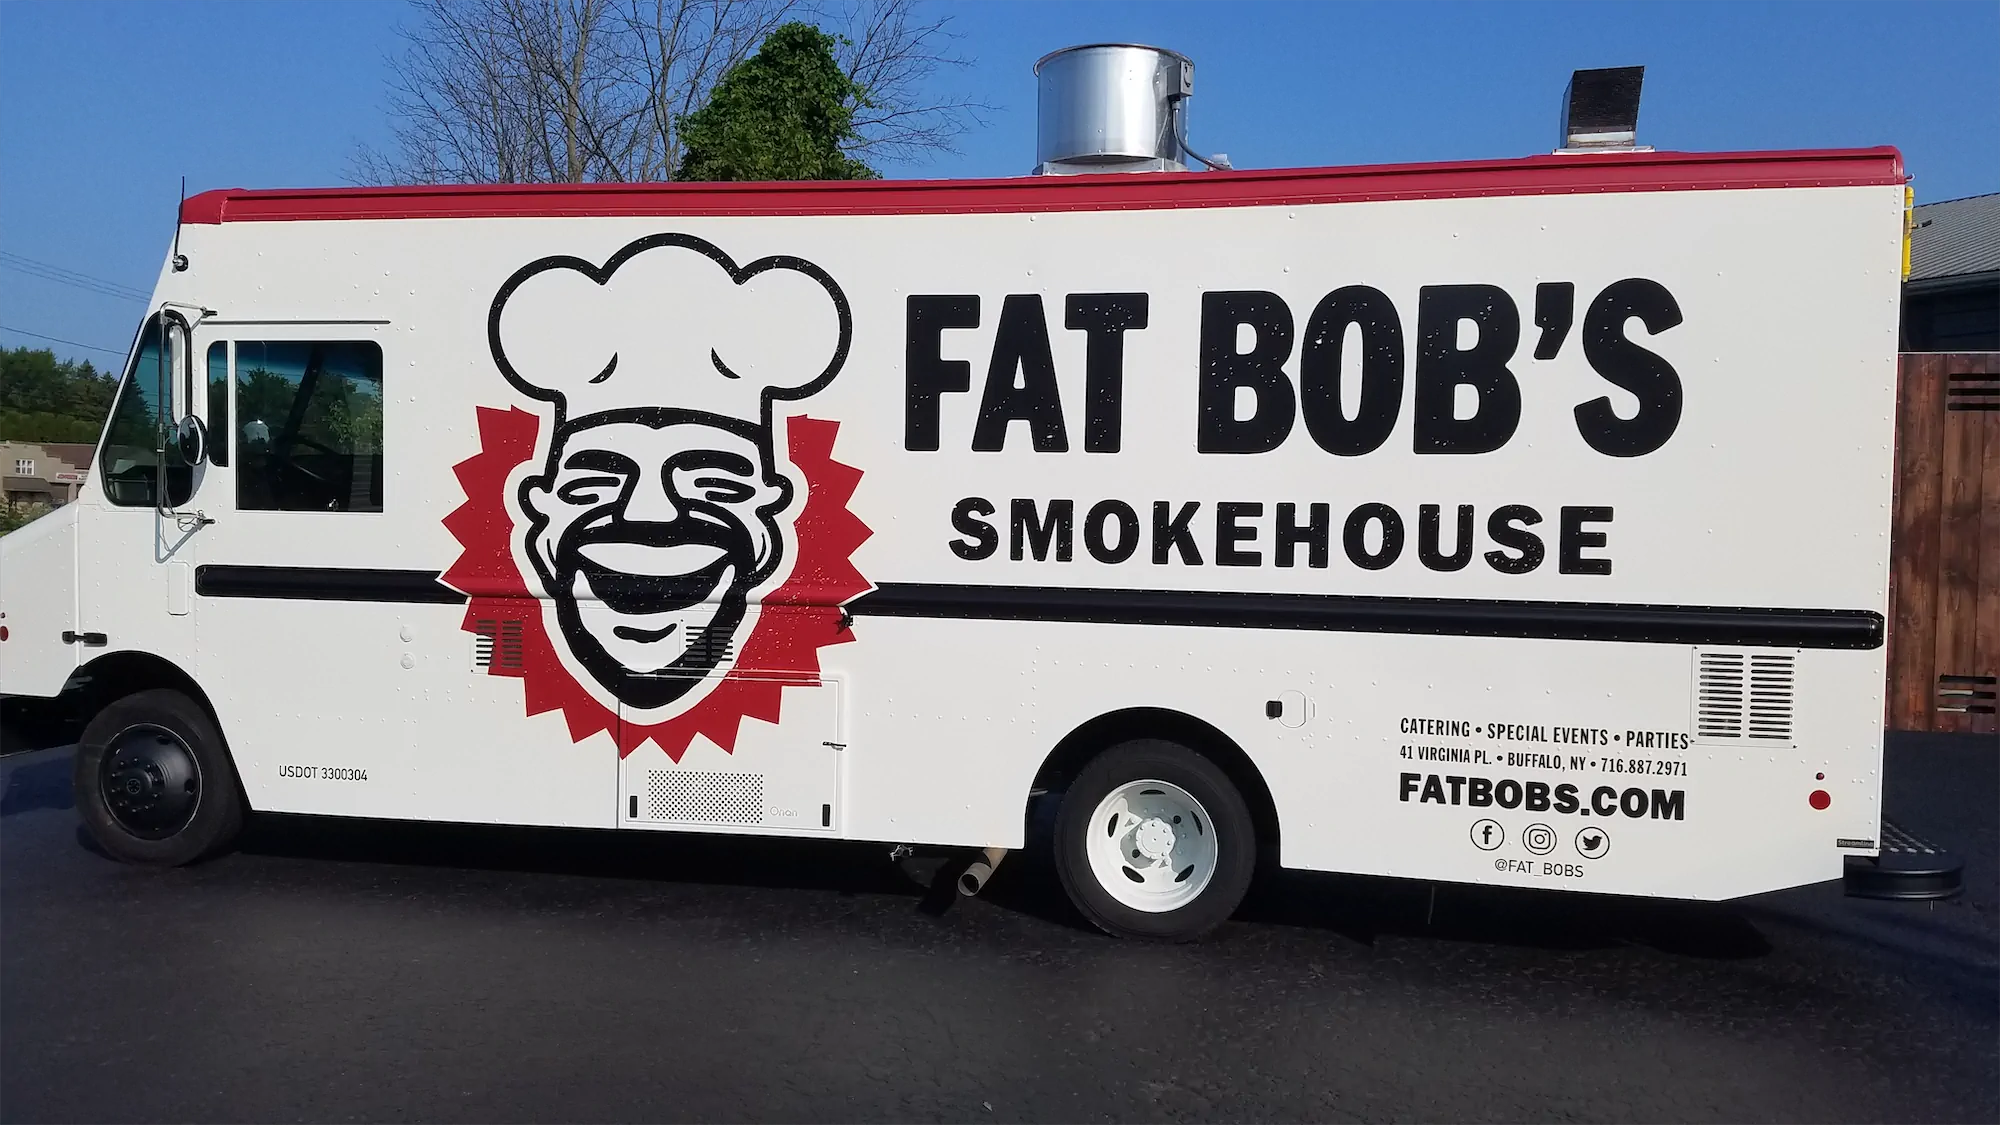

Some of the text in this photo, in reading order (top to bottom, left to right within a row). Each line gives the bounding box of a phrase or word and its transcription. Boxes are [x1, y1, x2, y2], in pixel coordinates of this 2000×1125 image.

[904, 278, 1684, 458] FAT BOB'S
[948, 497, 1614, 576] SMOKEHOUSE
[1401, 717, 1689, 750] CATERING SPECIAL EVENTS PARTIES
[279, 765, 368, 781] USDOT 3300304
[1399, 745, 1688, 776] 41 VIRGINIA PL. BUFFALO, NY 716.887.2971
[770, 806, 798, 817] Onan
[1400, 773, 1686, 821] FATBOBS.COM
[1495, 859, 1583, 878] @FAT_BOBS
